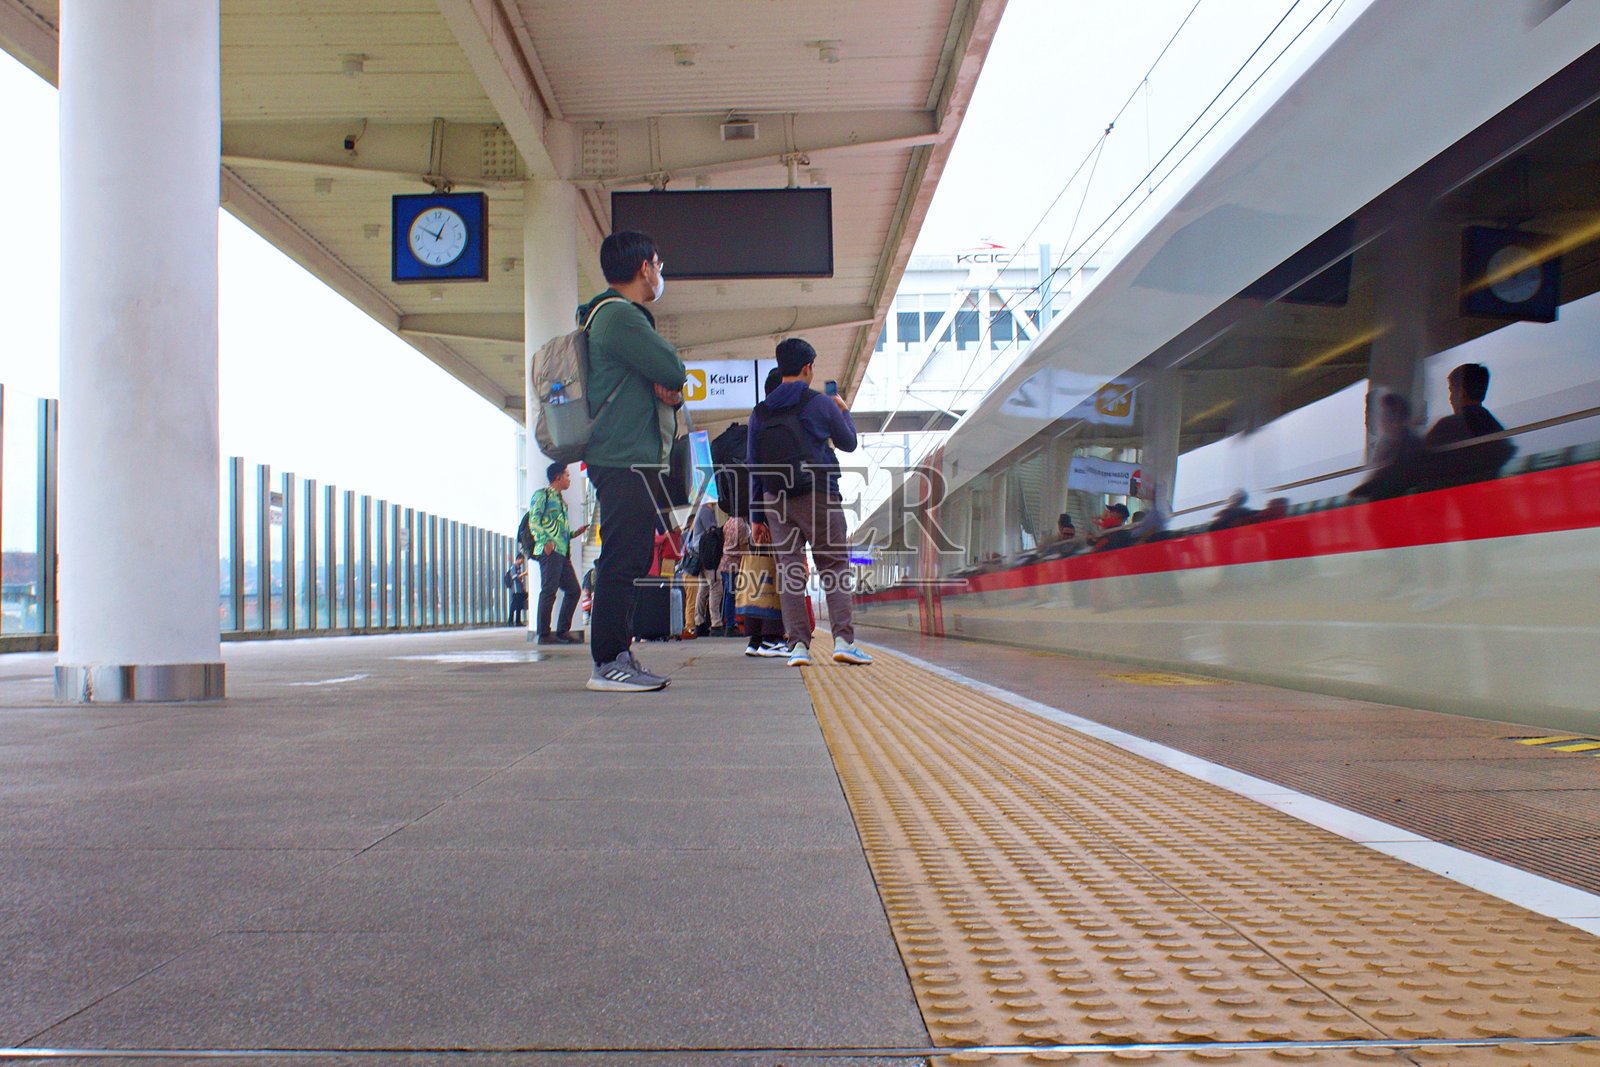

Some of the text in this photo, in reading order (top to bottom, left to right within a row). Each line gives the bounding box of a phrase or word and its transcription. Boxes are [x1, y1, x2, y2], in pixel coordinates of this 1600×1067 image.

[434, 211, 442, 219] 12
[458, 232, 462, 241] 3
[957, 253, 1010, 264] KCIC
[710, 374, 749, 384] Keluar
